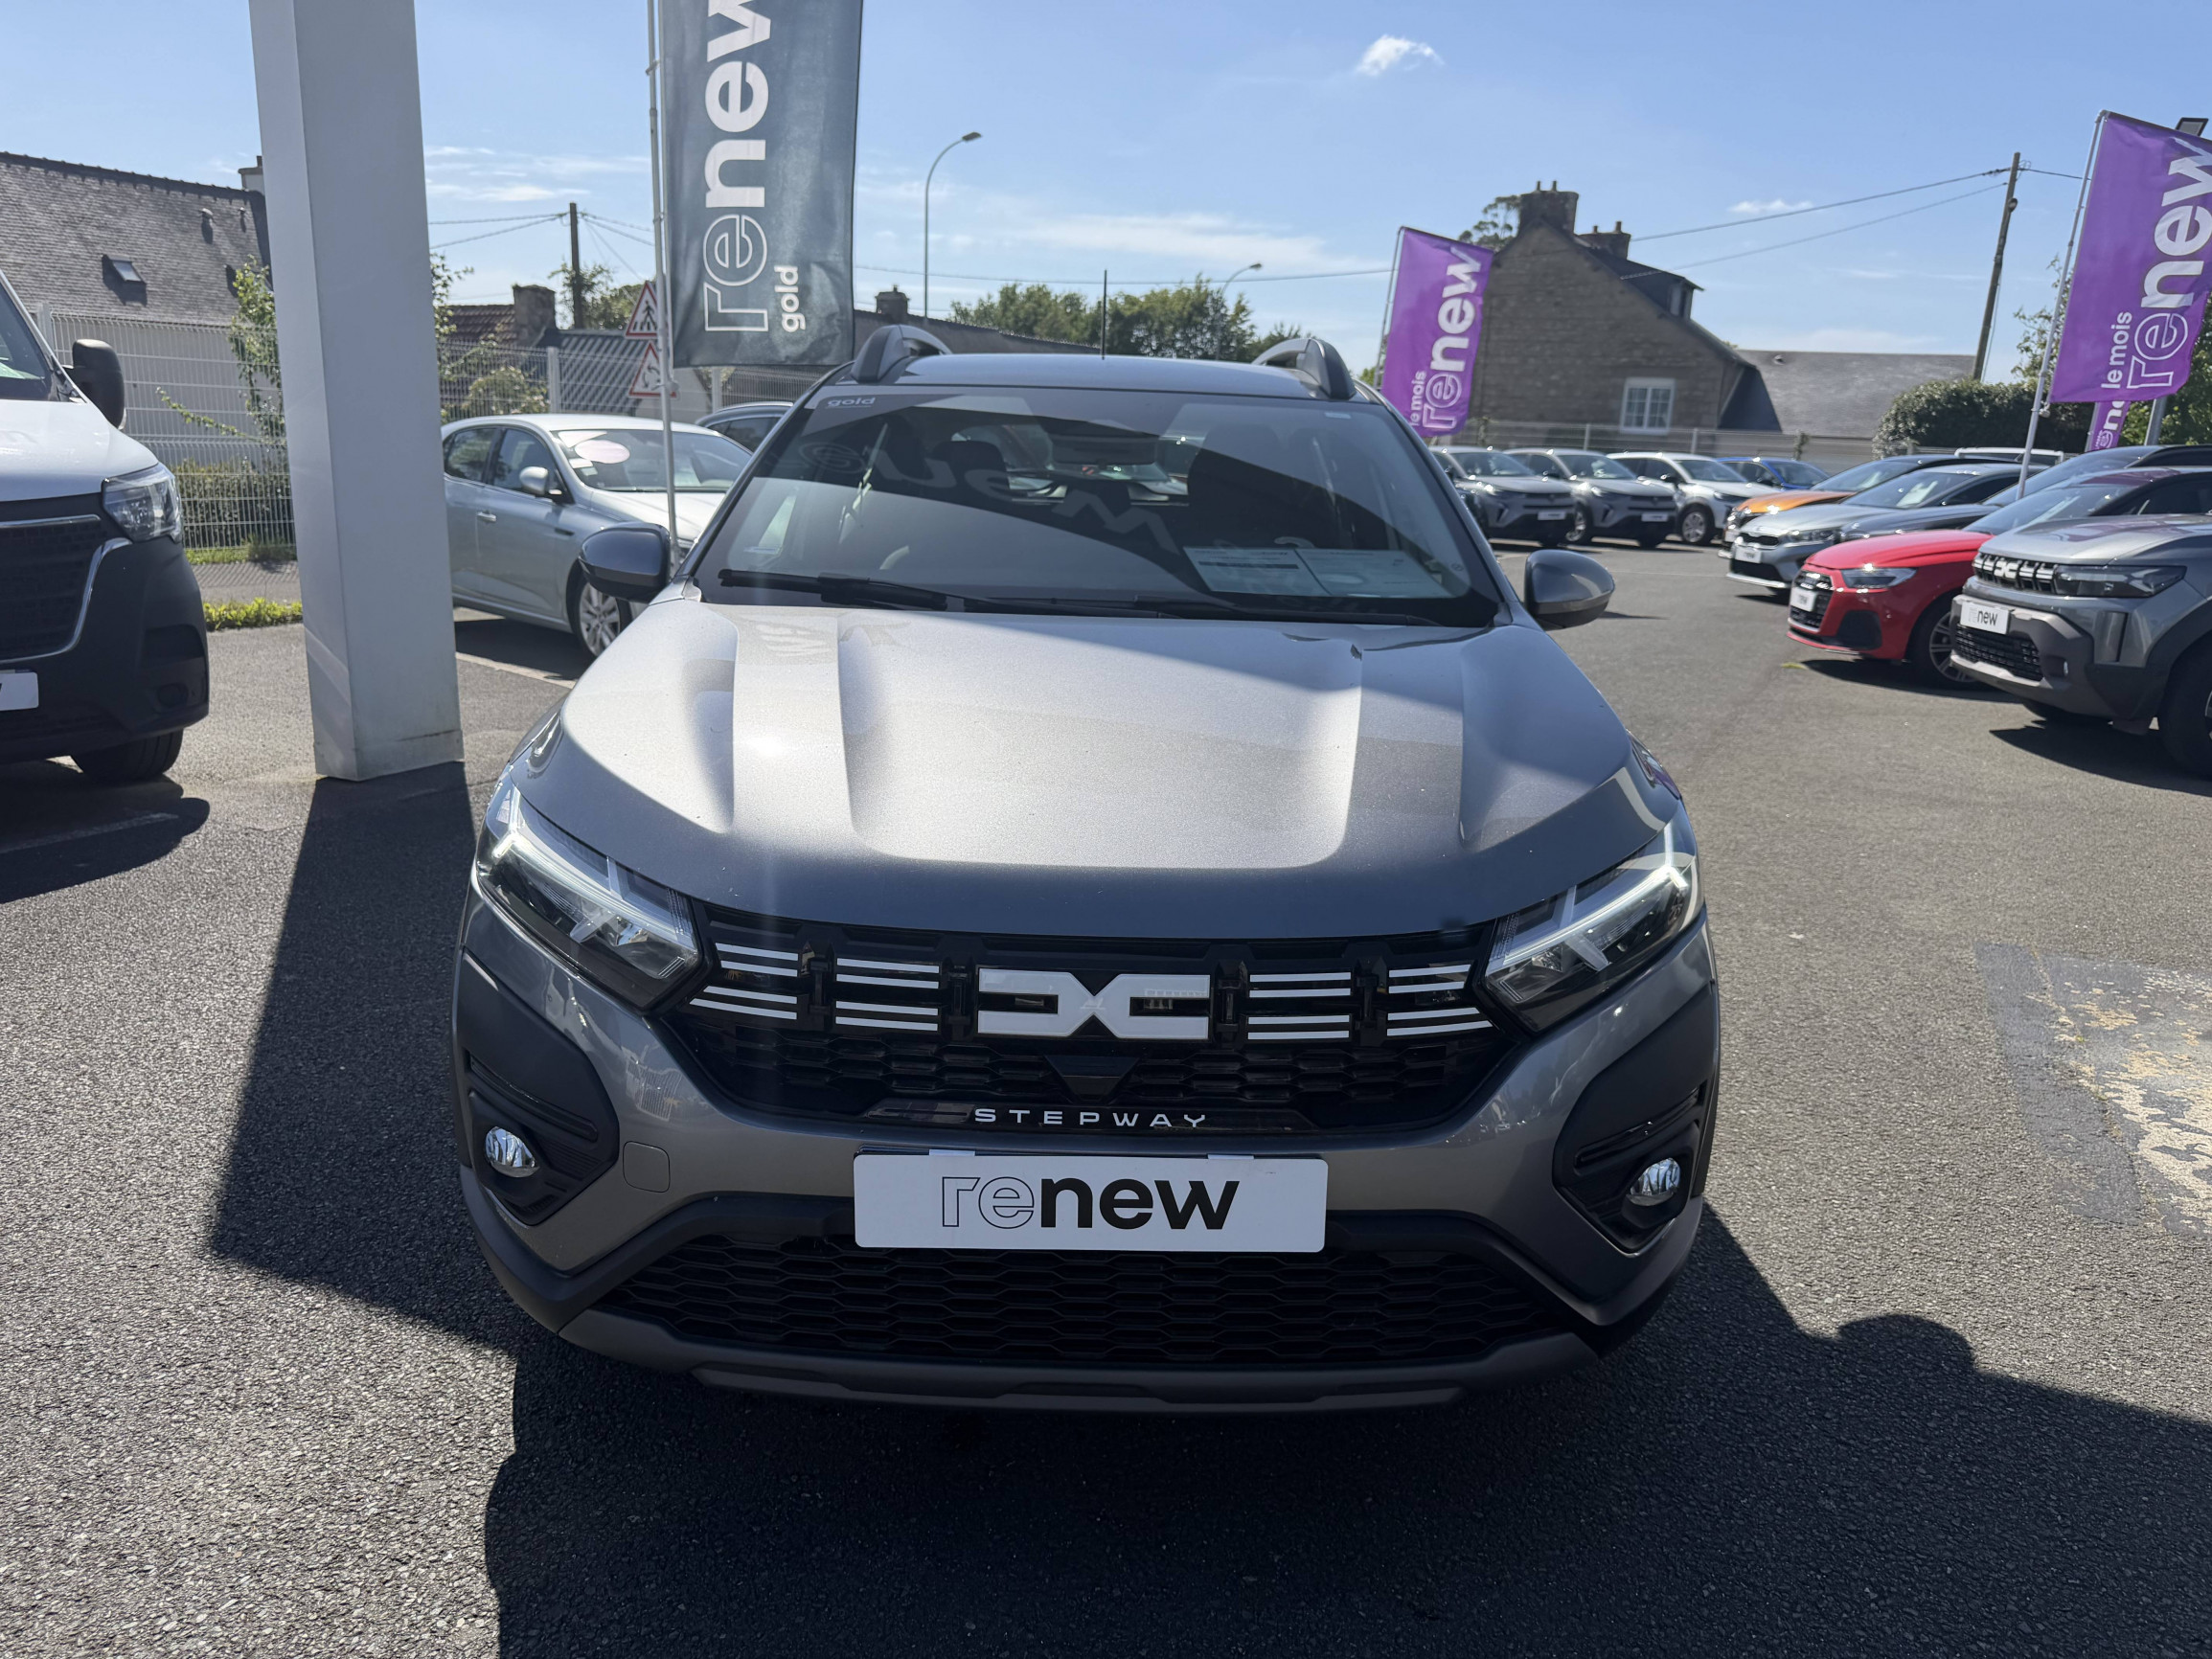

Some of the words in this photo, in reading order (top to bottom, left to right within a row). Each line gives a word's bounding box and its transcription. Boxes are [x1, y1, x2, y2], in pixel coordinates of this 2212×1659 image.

[774, 264, 806, 333] gold
[1422, 246, 1482, 429] renew
[2109, 311, 2132, 368] mois
[1411, 371, 1426, 411] mois
[2101, 369, 2124, 390] le
[1408, 412, 1420, 426] le
[973, 1108, 1207, 1128] STEPWAY
[941, 1175, 1241, 1231] renew
